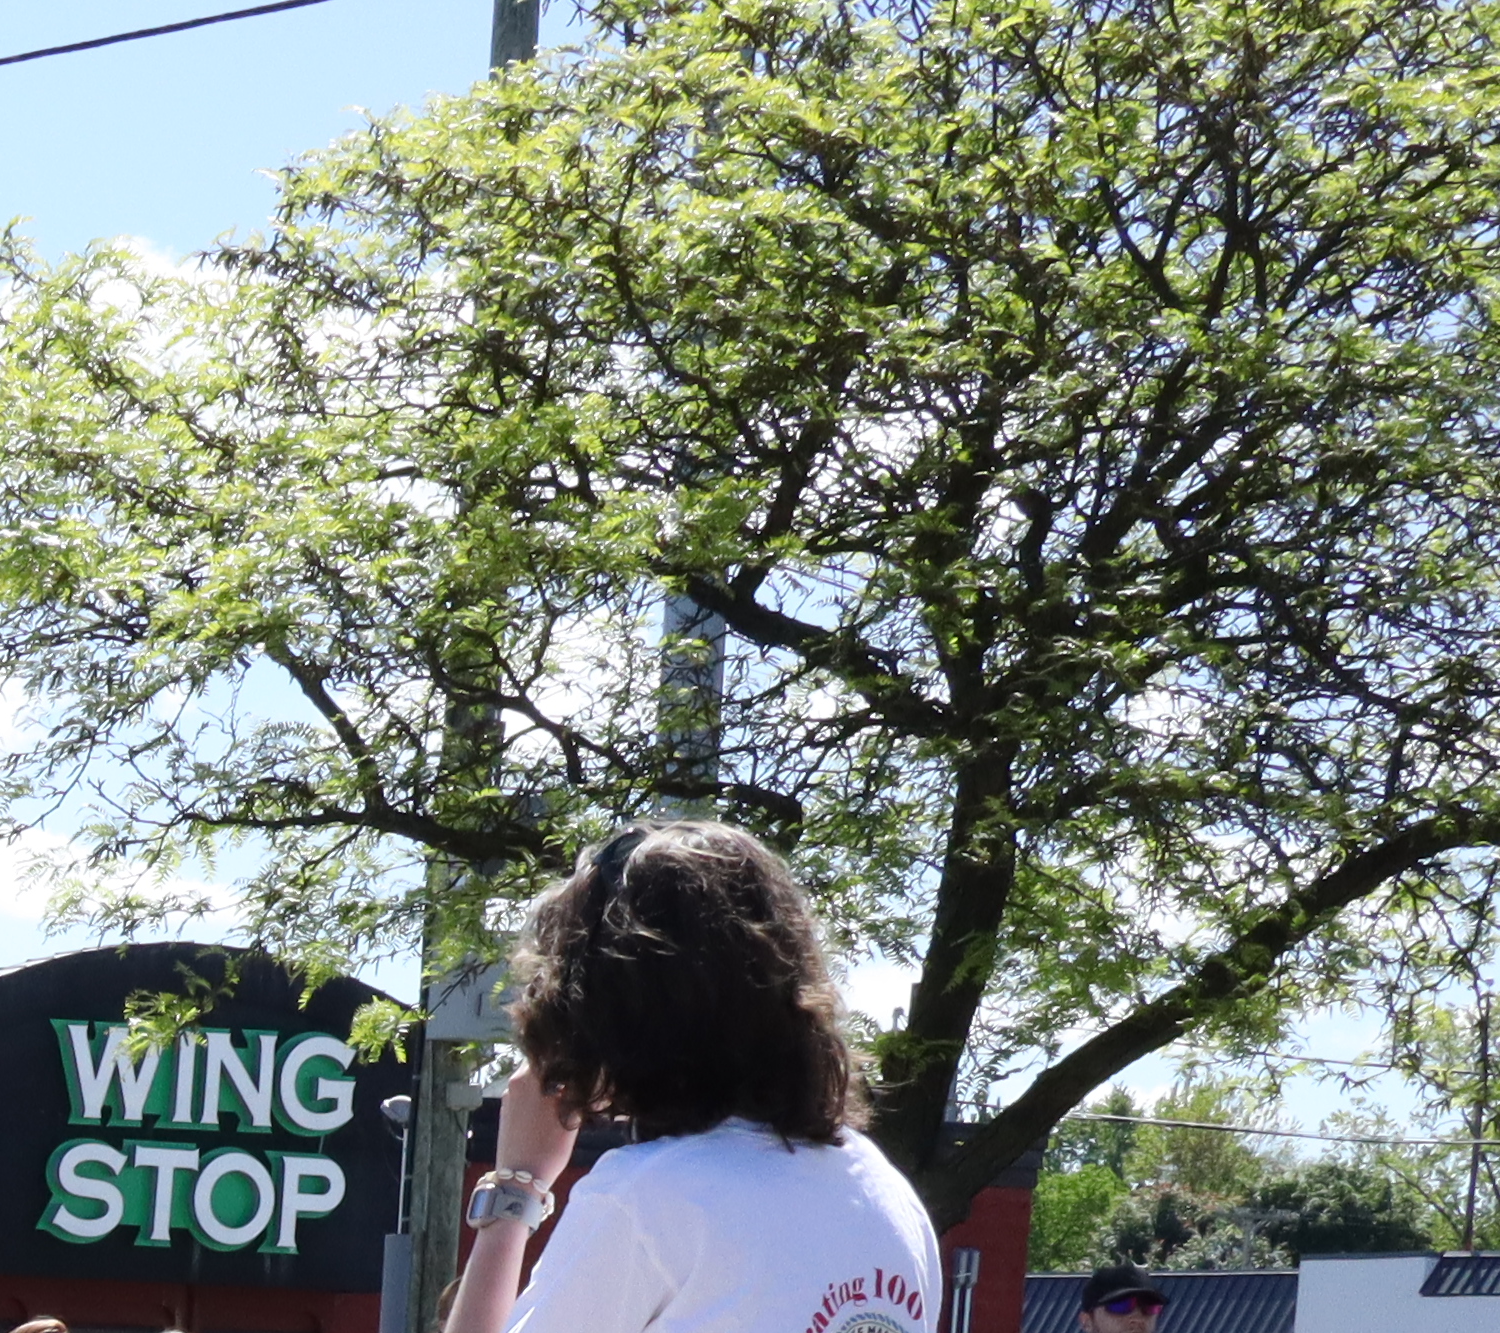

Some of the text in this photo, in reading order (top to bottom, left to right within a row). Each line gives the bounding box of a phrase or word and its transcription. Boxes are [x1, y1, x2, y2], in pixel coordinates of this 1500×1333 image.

[66, 1022, 357, 1133] WING
[51, 1142, 347, 1250] STOP
[872, 1266, 924, 1322] 100
